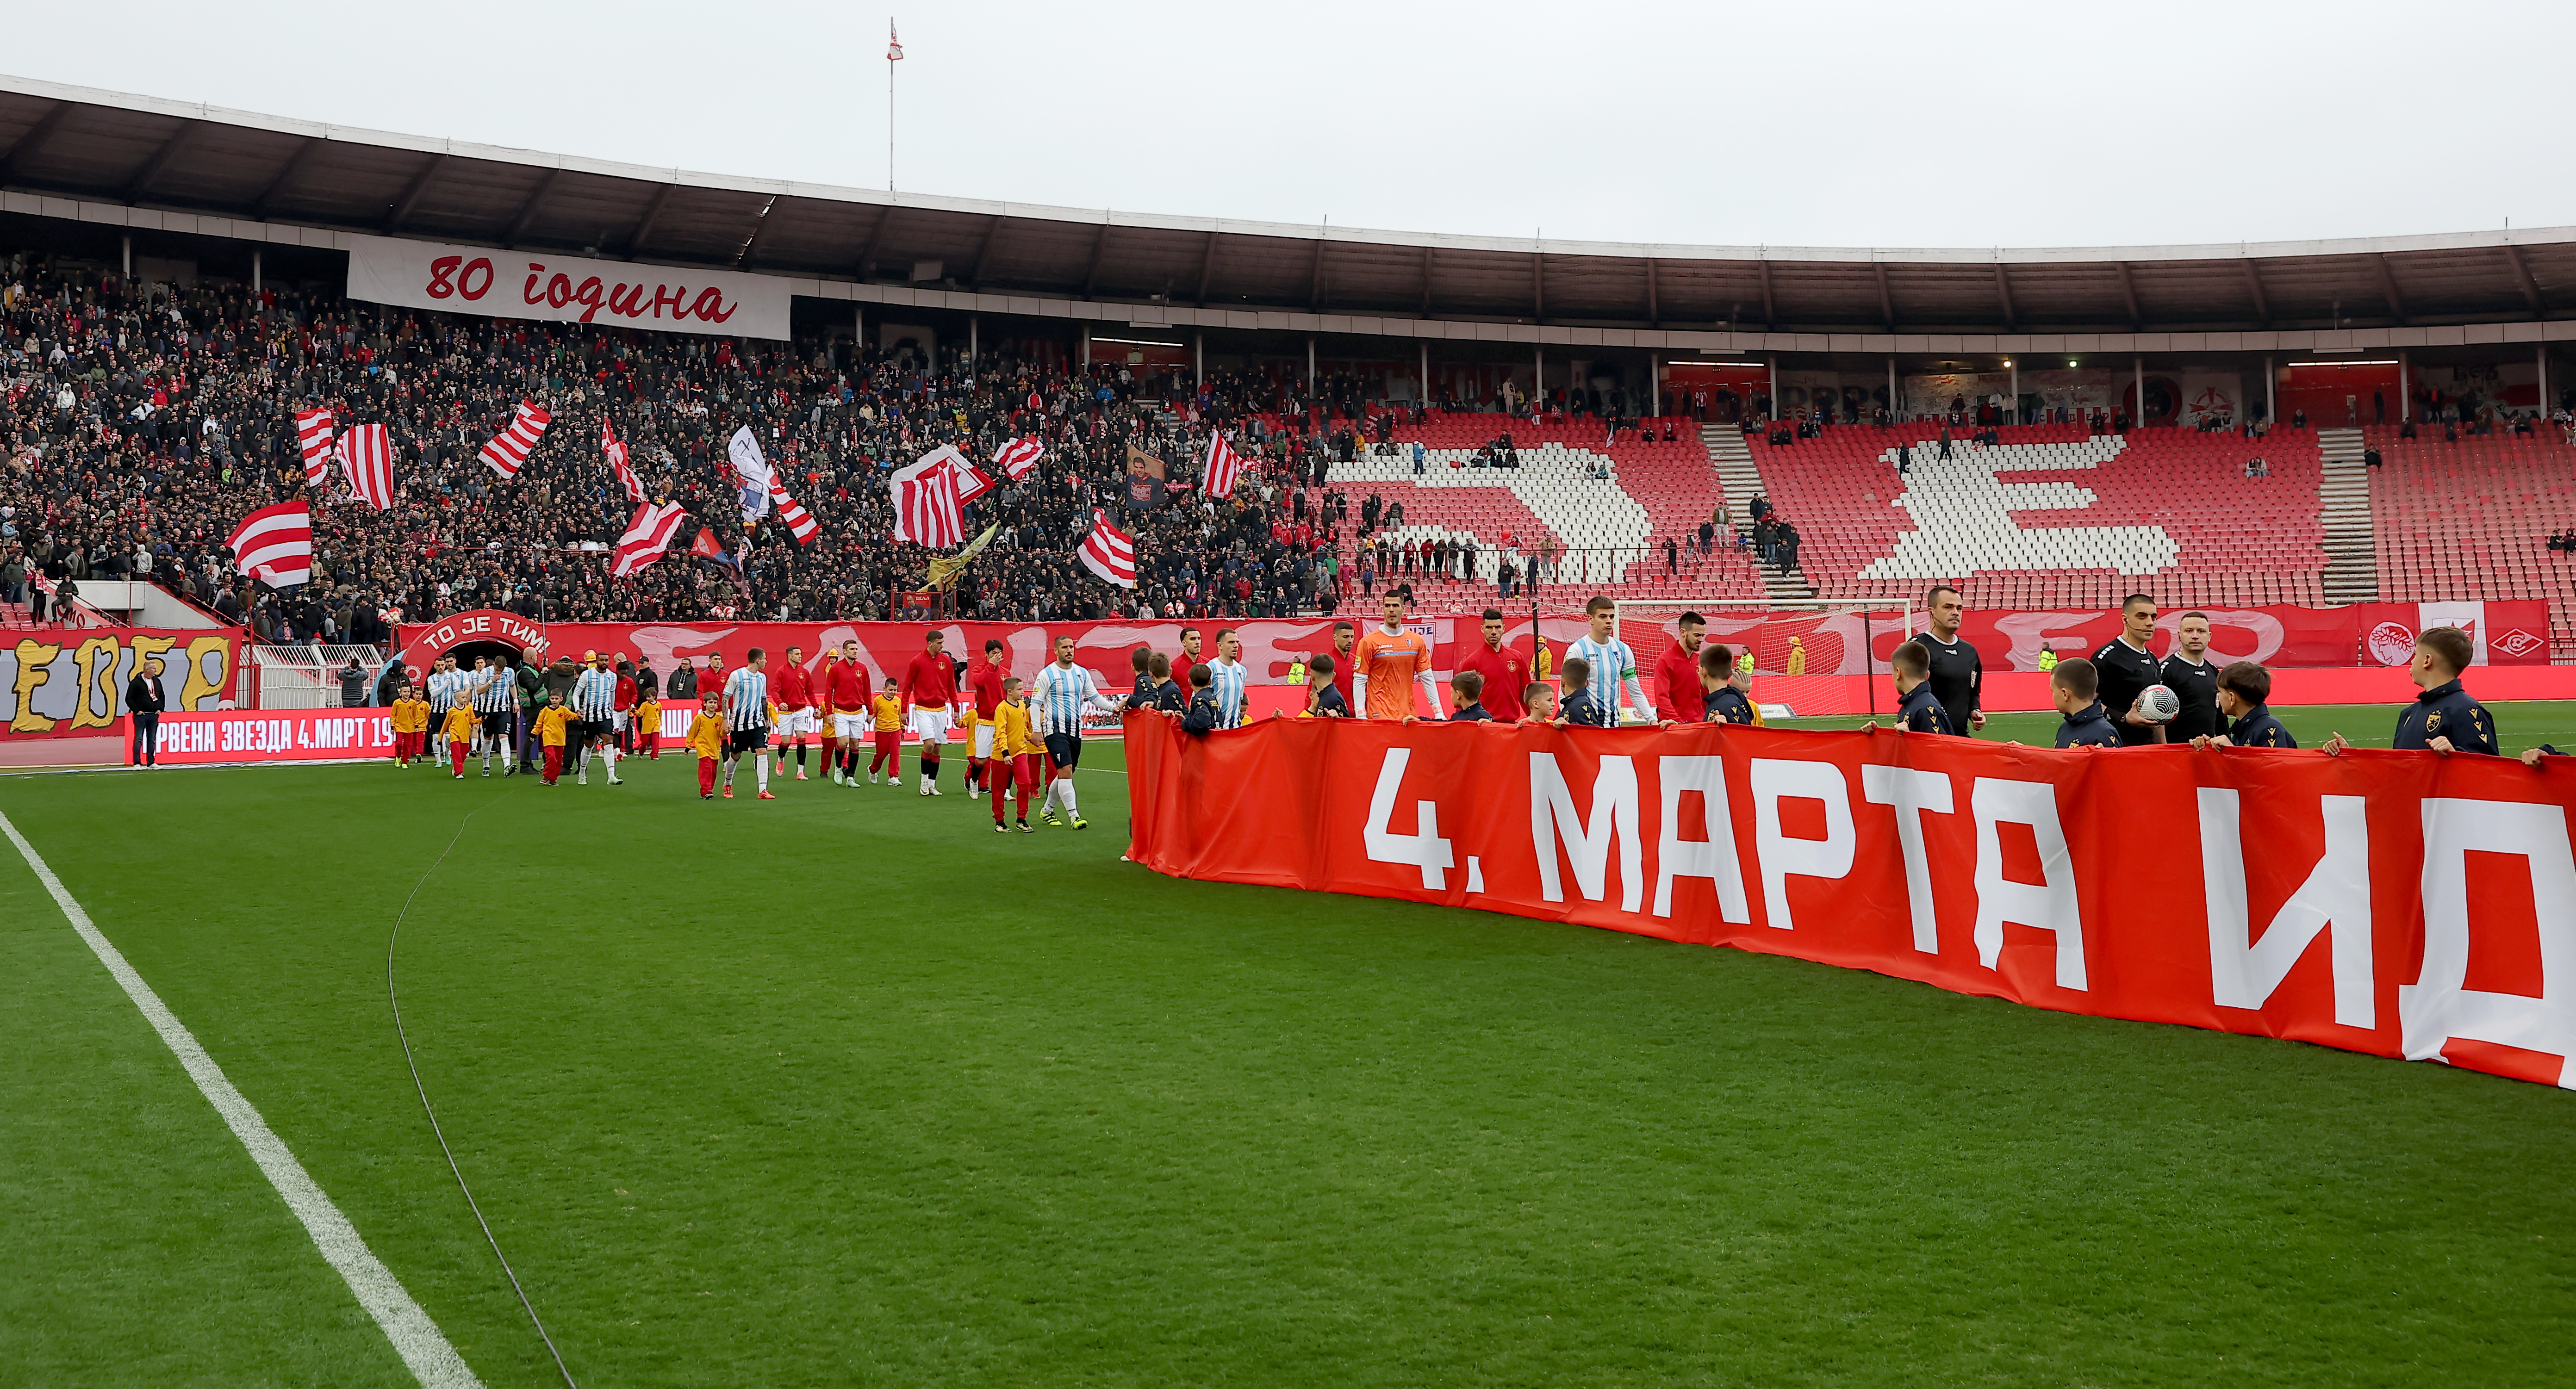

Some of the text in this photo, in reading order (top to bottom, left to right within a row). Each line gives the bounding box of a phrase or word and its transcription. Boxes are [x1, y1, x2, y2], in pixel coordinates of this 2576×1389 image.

[426, 255, 738, 322] 80 година
[423, 616, 551, 653] ТО ЈЕ ТИМ!
[143, 721, 216, 757] РВЕНА
[221, 719, 292, 754] ЗВЕЗДА
[371, 716, 395, 747] 19
[1363, 747, 1484, 893] 4.
[1529, 751, 2088, 992] МАРТА
